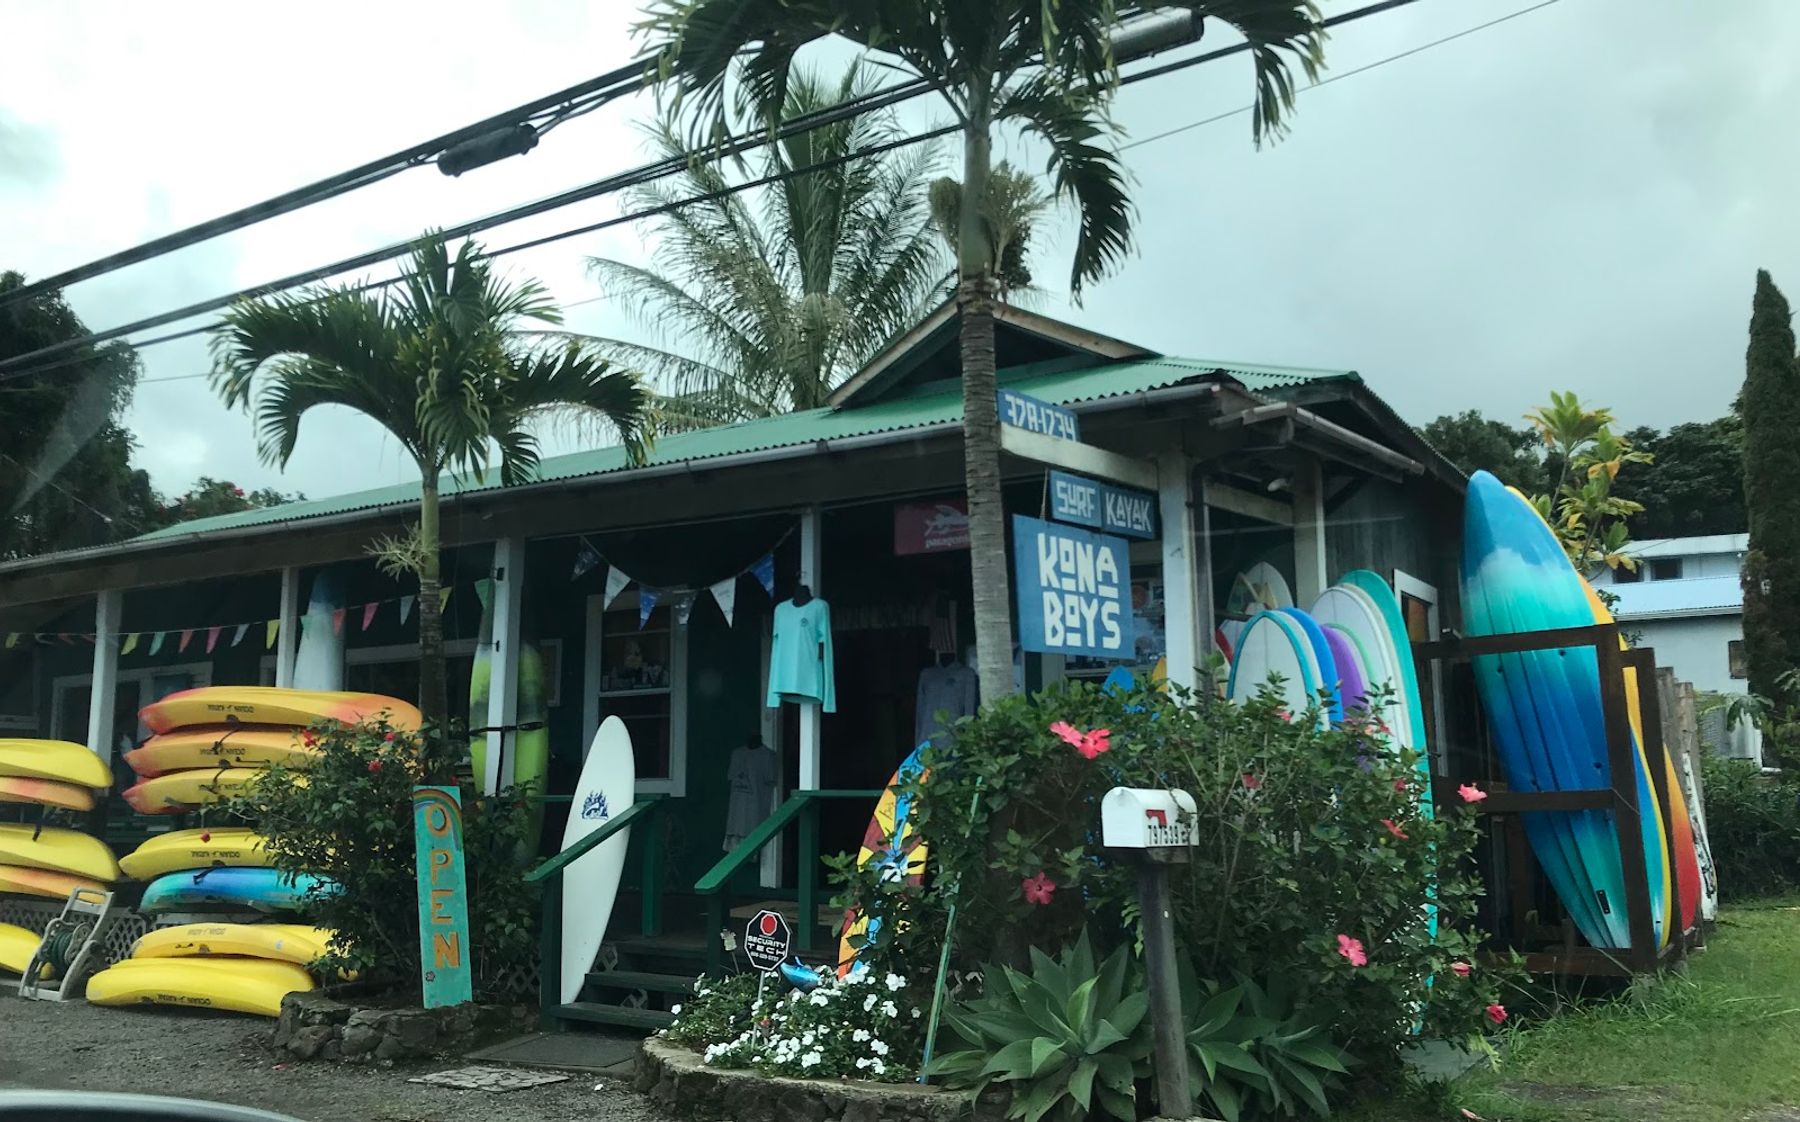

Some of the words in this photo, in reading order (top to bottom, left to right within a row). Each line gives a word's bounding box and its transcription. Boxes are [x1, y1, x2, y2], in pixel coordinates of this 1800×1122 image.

[1056, 480, 1096, 518] SURF
[1105, 492, 1152, 532] KAYAK
[1037, 532, 1119, 599] KONA
[1042, 590, 1121, 650] BOYS
[425, 801, 461, 969] OPEN
[747, 935, 786, 949] SECURITY
[747, 942, 786, 956] TECH
